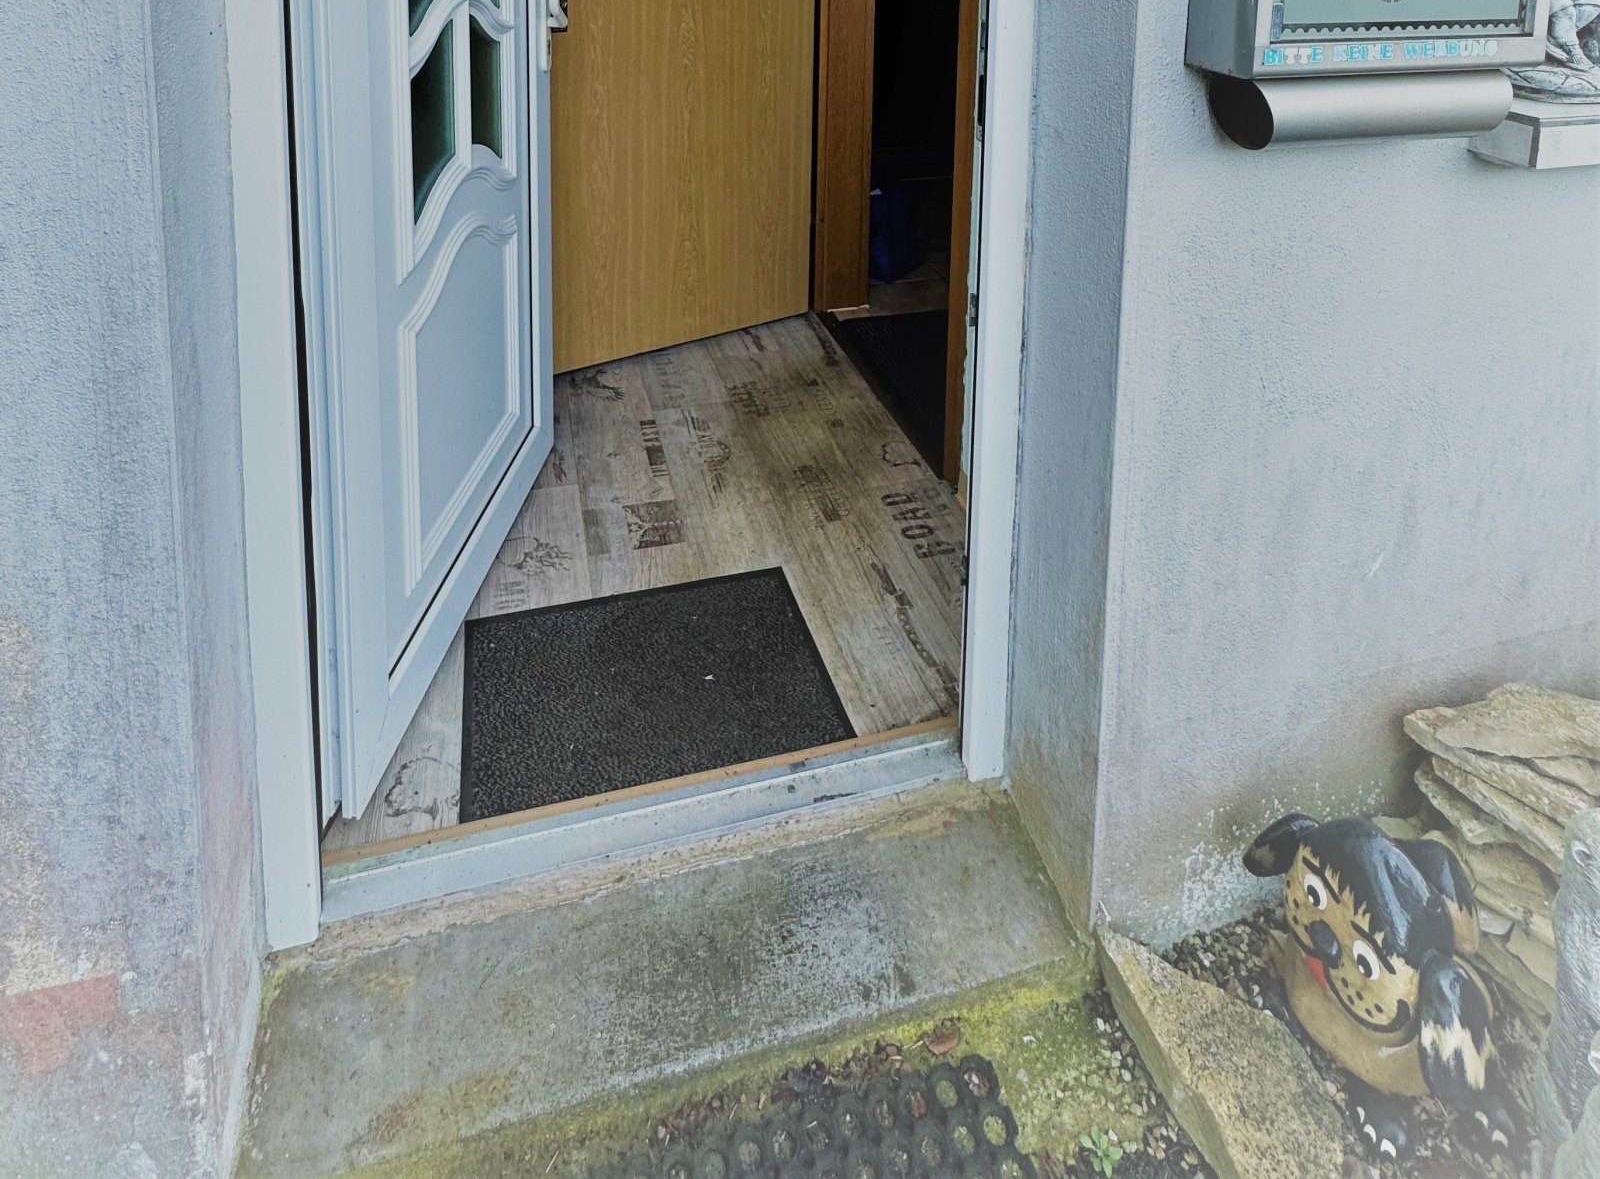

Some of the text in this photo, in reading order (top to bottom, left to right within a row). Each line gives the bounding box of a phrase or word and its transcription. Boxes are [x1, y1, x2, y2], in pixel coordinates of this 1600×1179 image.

[1263, 38, 1498, 66] BITTE KEINE WERBUNG
